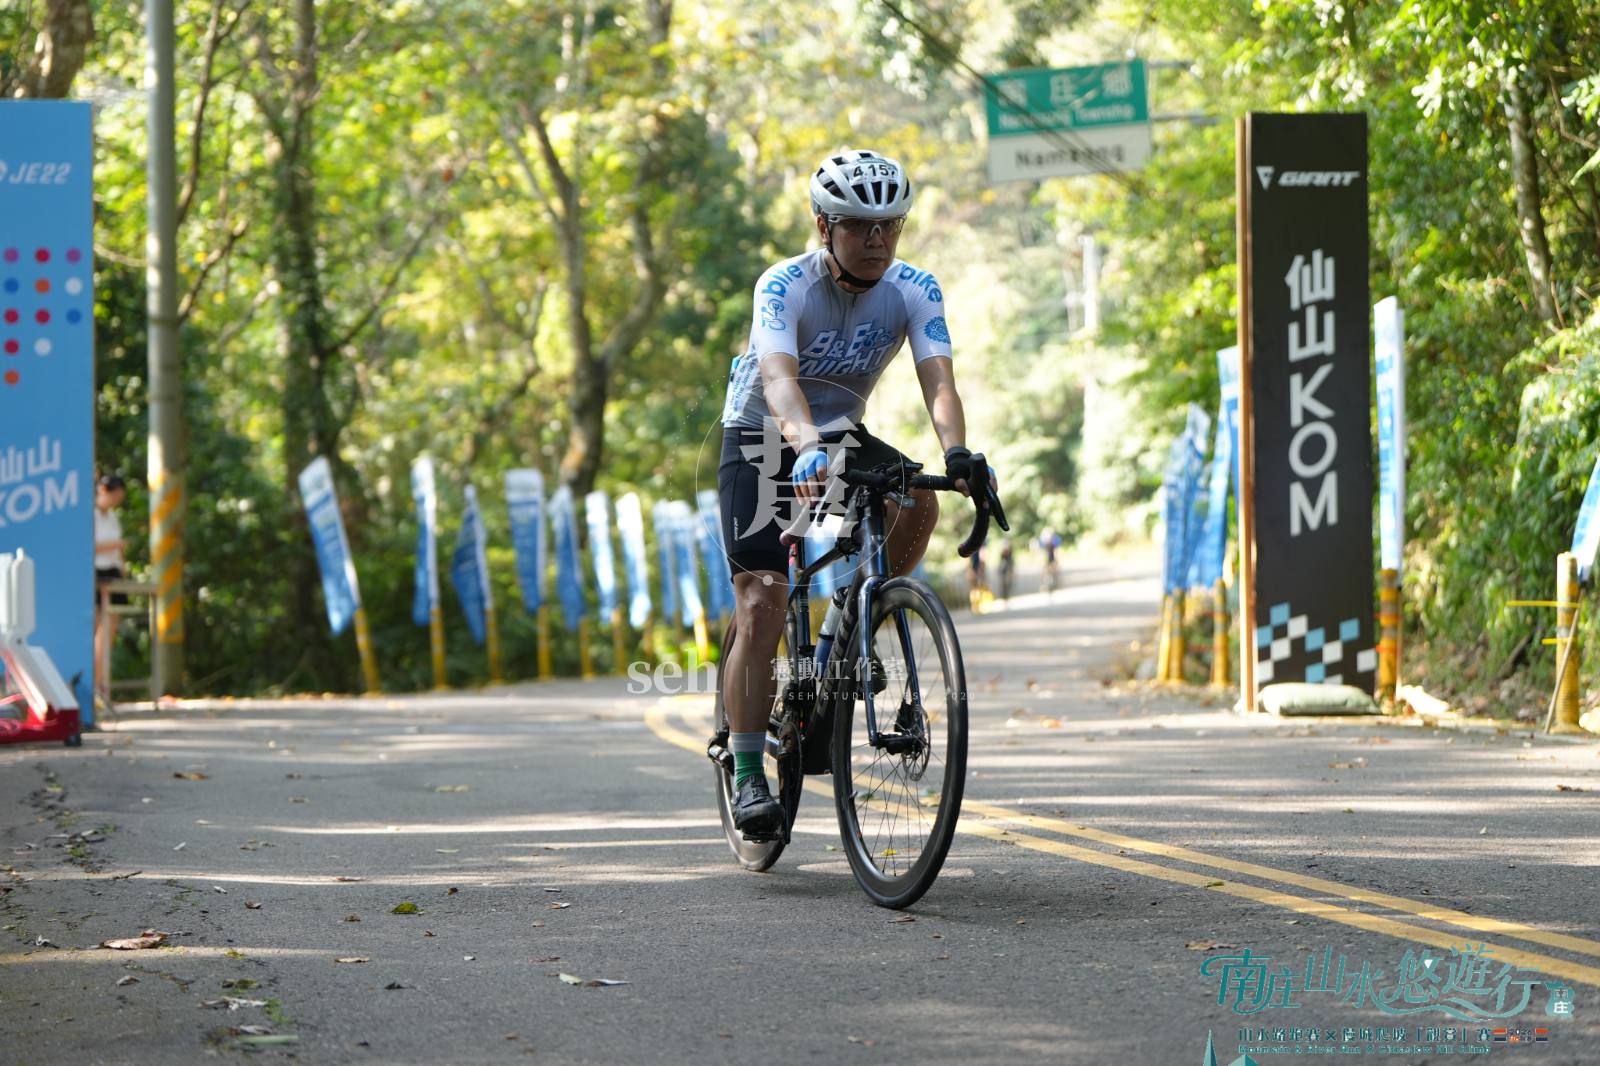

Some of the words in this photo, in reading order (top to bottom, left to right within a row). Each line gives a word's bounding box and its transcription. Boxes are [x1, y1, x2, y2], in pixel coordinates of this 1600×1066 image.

[9, 162, 72, 184] JE22
[1278, 171, 1361, 187] GIANT
[1285, 249, 1336, 362] 仙山
[1288, 363, 1338, 537] KOM
